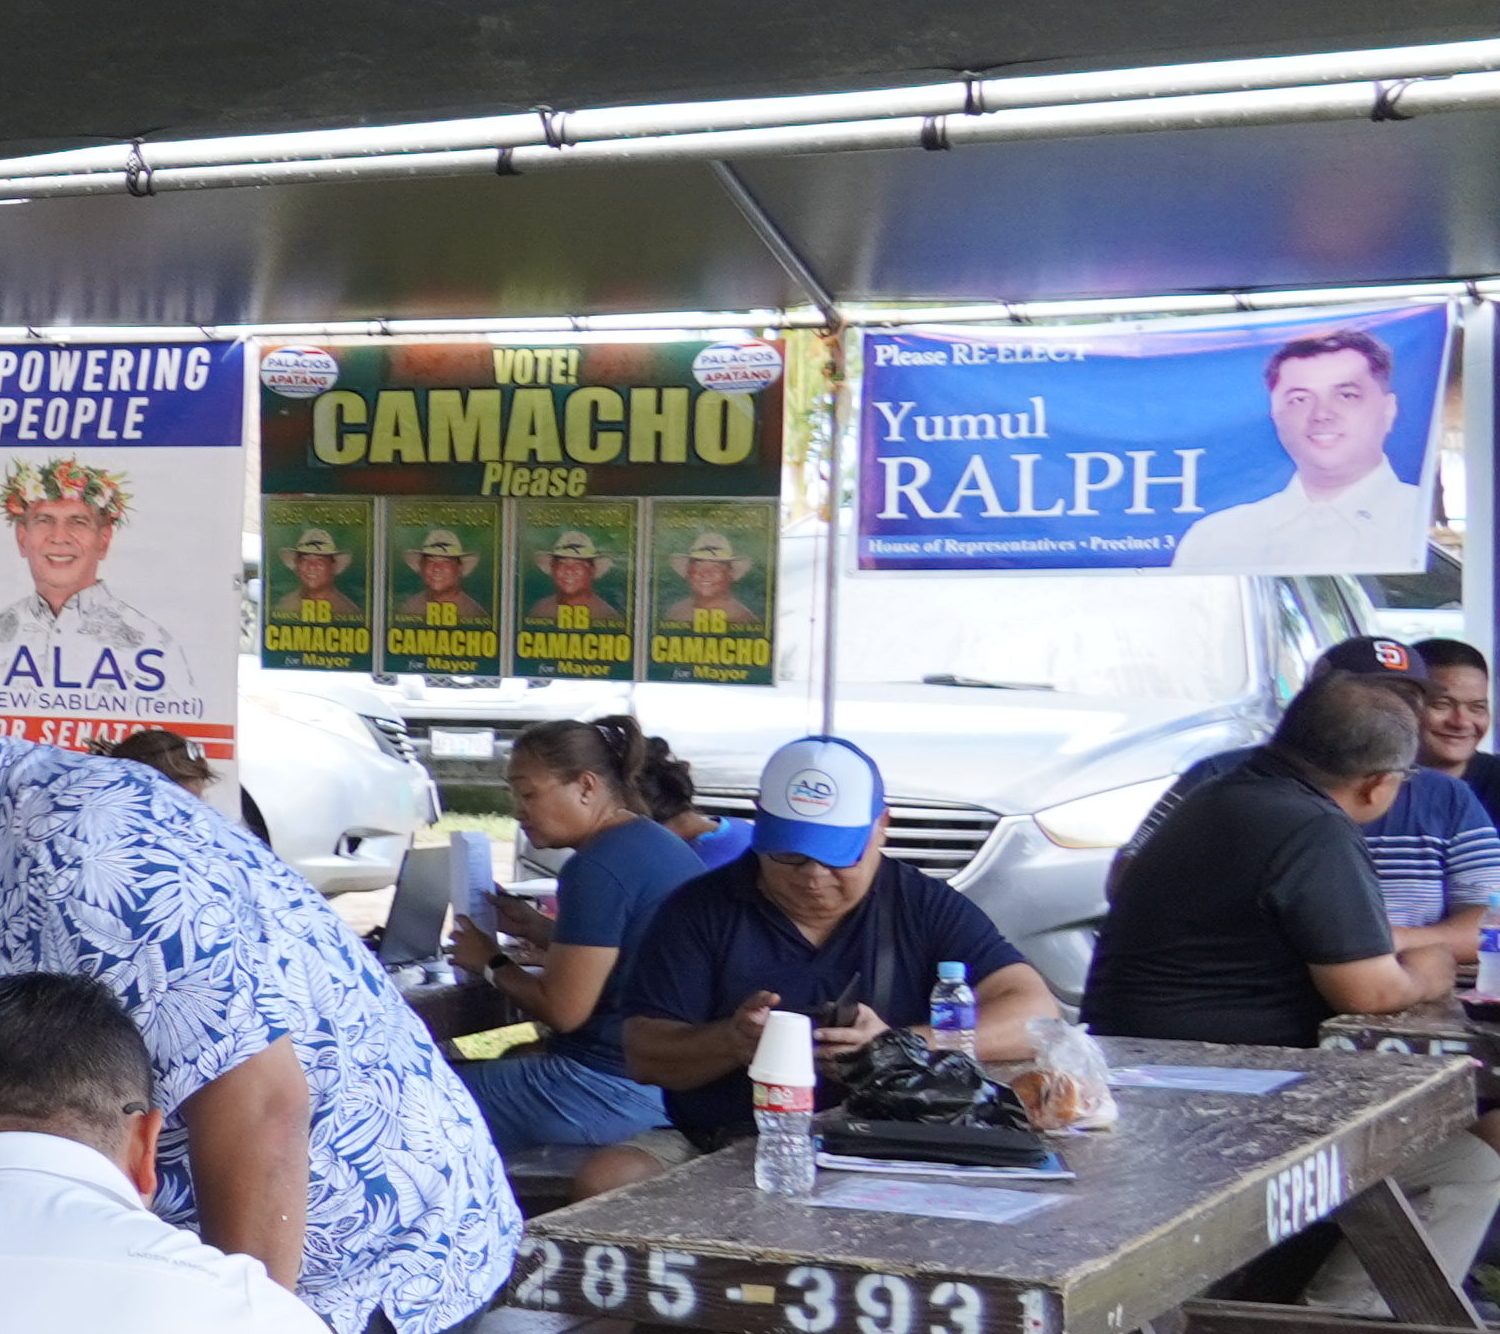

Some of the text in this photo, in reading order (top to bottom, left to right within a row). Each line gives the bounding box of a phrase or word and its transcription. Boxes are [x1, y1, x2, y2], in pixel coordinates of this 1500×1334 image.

[267, 357, 331, 369] PALACIOS
[493, 348, 579, 385] VOTE!
[701, 351, 774, 365] PALACIOS
[875, 343, 1092, 367] Please RE-ELECT
[268, 375, 328, 387] APATANG
[313, 387, 755, 465] CAMACHO
[873, 396, 1049, 442] Yumul
[481, 461, 587, 497] Please
[876, 448, 1207, 520] RALPH
[869, 535, 1175, 556] House of Representatives Precinct 3
[301, 599, 332, 623] RB
[426, 602, 457, 627] RB
[557, 605, 590, 629] RB
[693, 608, 727, 633] RB
[265, 625, 370, 654] CAMACHO
[388, 628, 497, 658] CAMACHO
[517, 632, 631, 662] CAMACHO
[652, 635, 770, 666] CAMACHO
[302, 653, 351, 668] Mayor
[426, 657, 478, 672] Mayor
[557, 661, 611, 677] Mayor
[693, 665, 749, 681] Mayor
[39, 692, 127, 713] SABLAN
[135, 696, 204, 720] (Tenti)
[1265, 1144, 1342, 1245] CEPEDA
